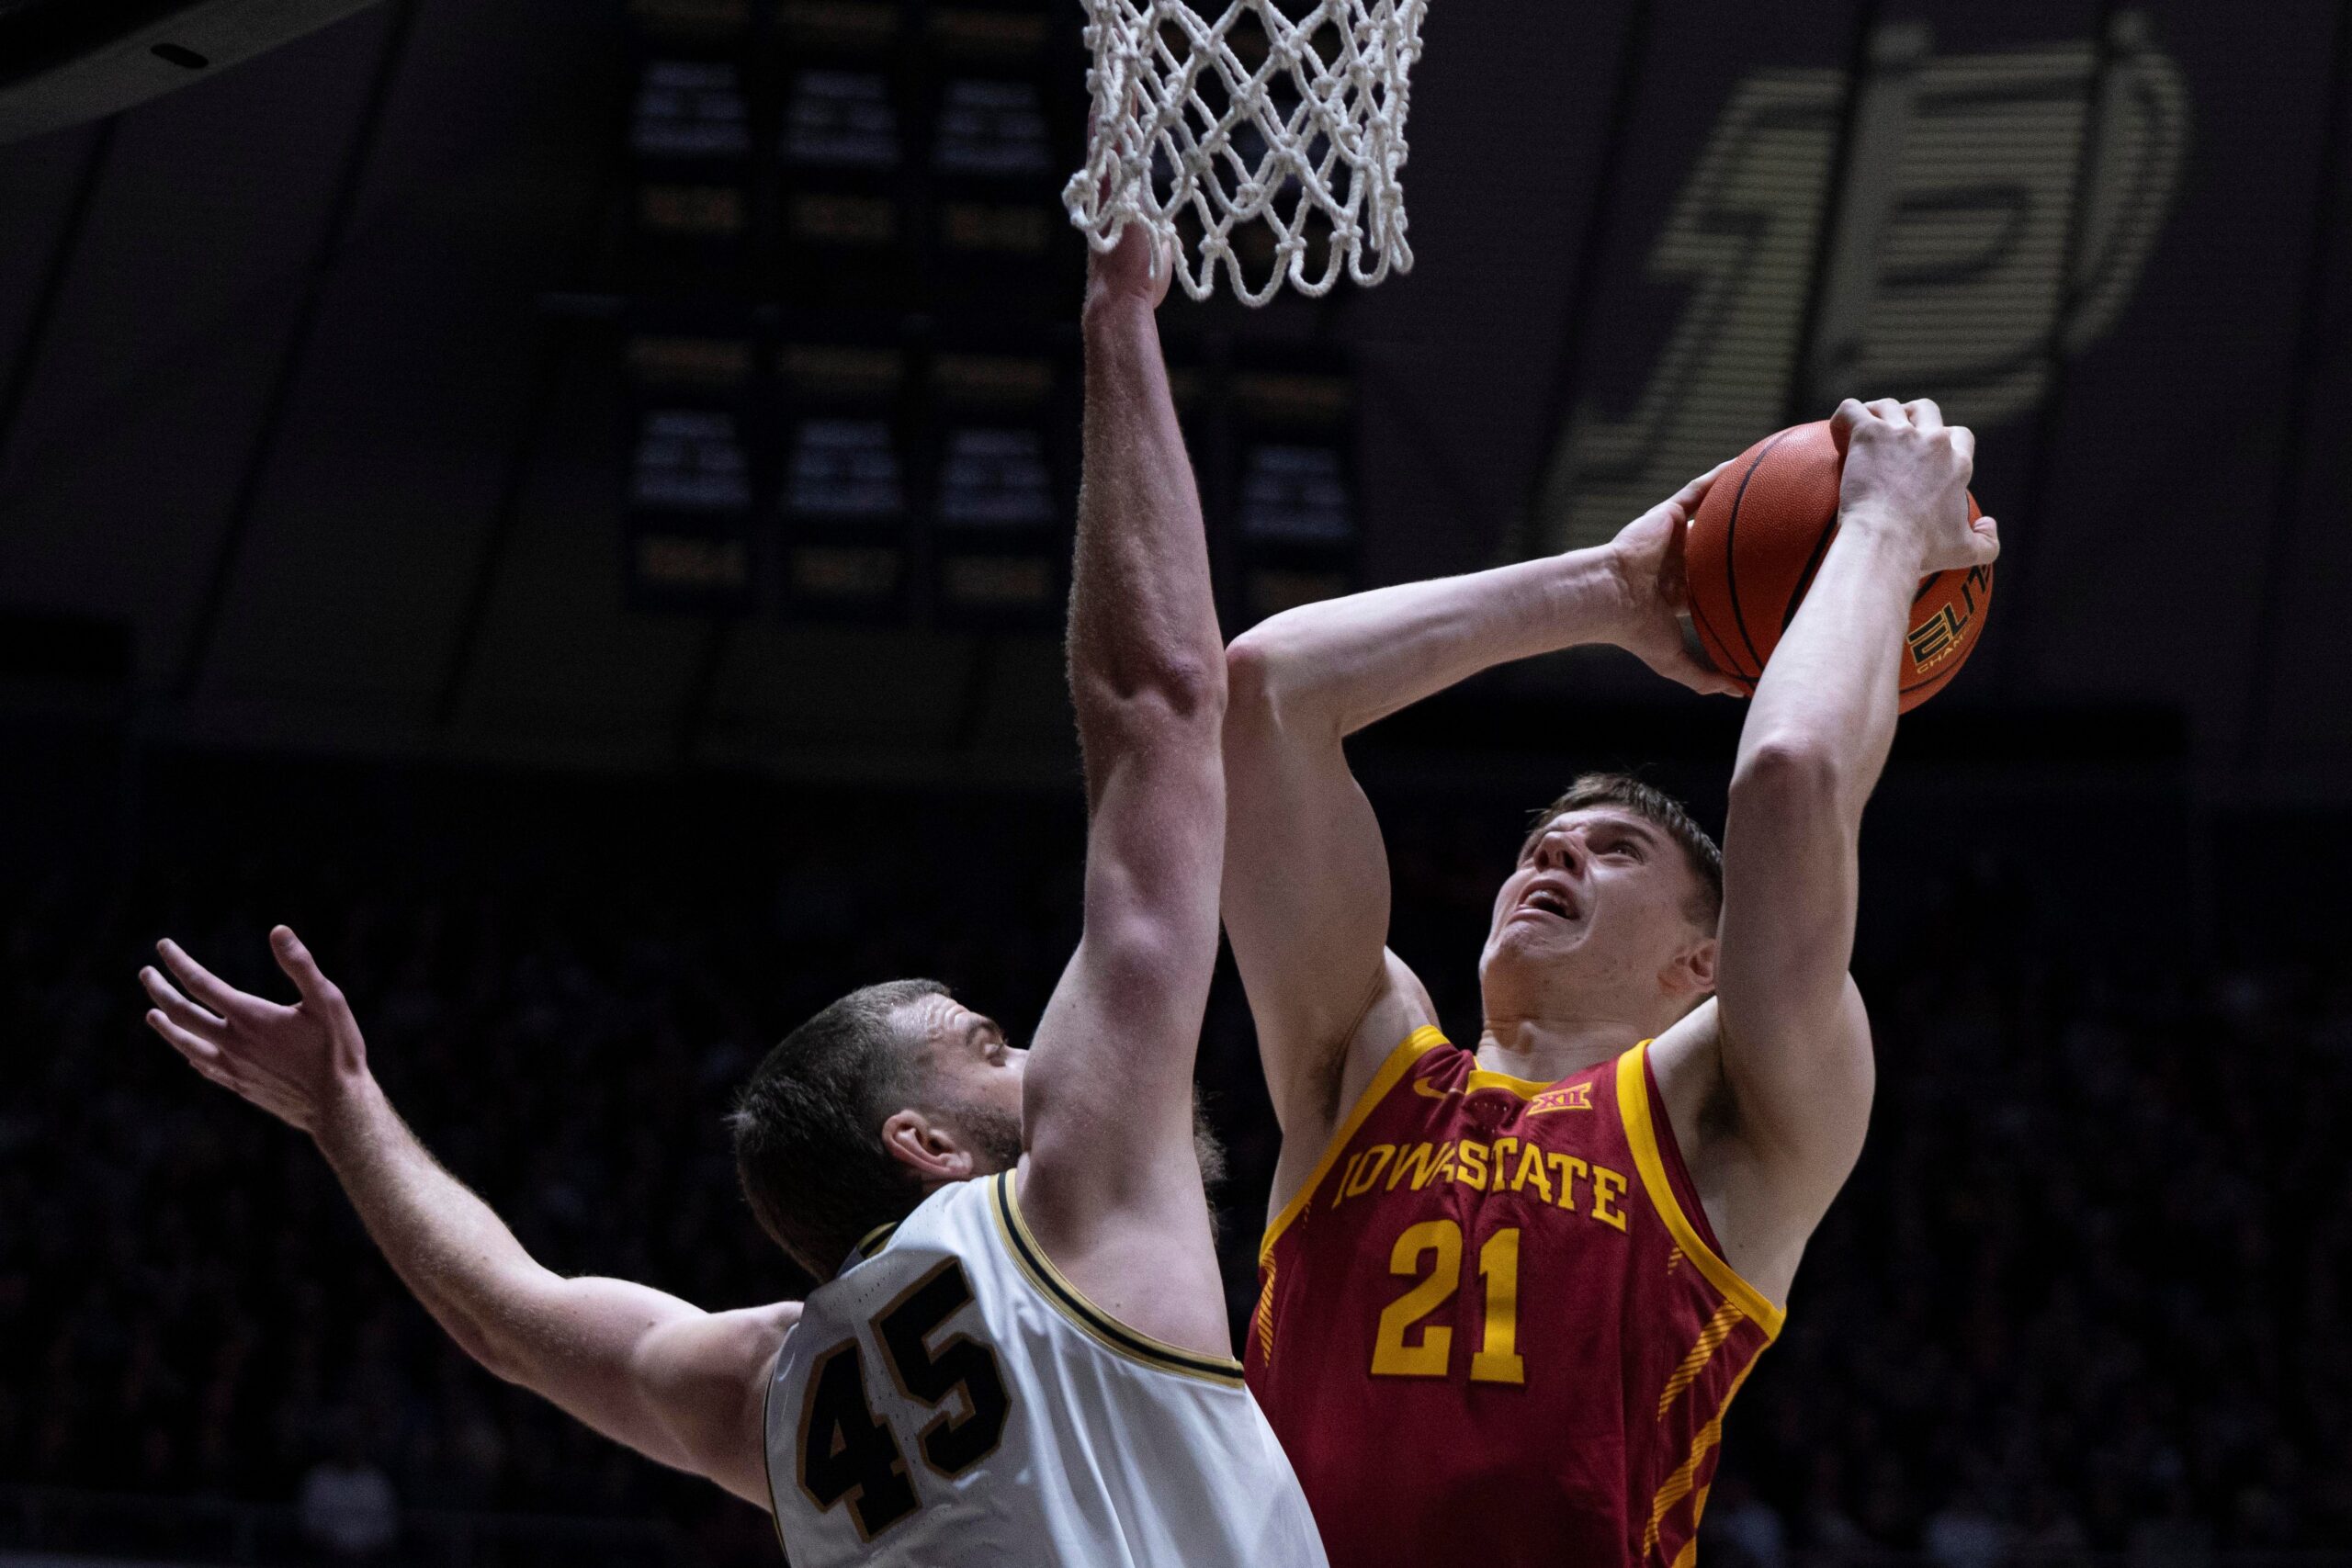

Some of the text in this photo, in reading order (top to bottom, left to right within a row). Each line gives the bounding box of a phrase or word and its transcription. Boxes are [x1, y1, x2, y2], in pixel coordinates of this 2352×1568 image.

[1331, 1136, 1629, 1234] IOWA STATE
[1371, 1219, 1524, 1384] 21
[796, 1255, 1011, 1543] 45
